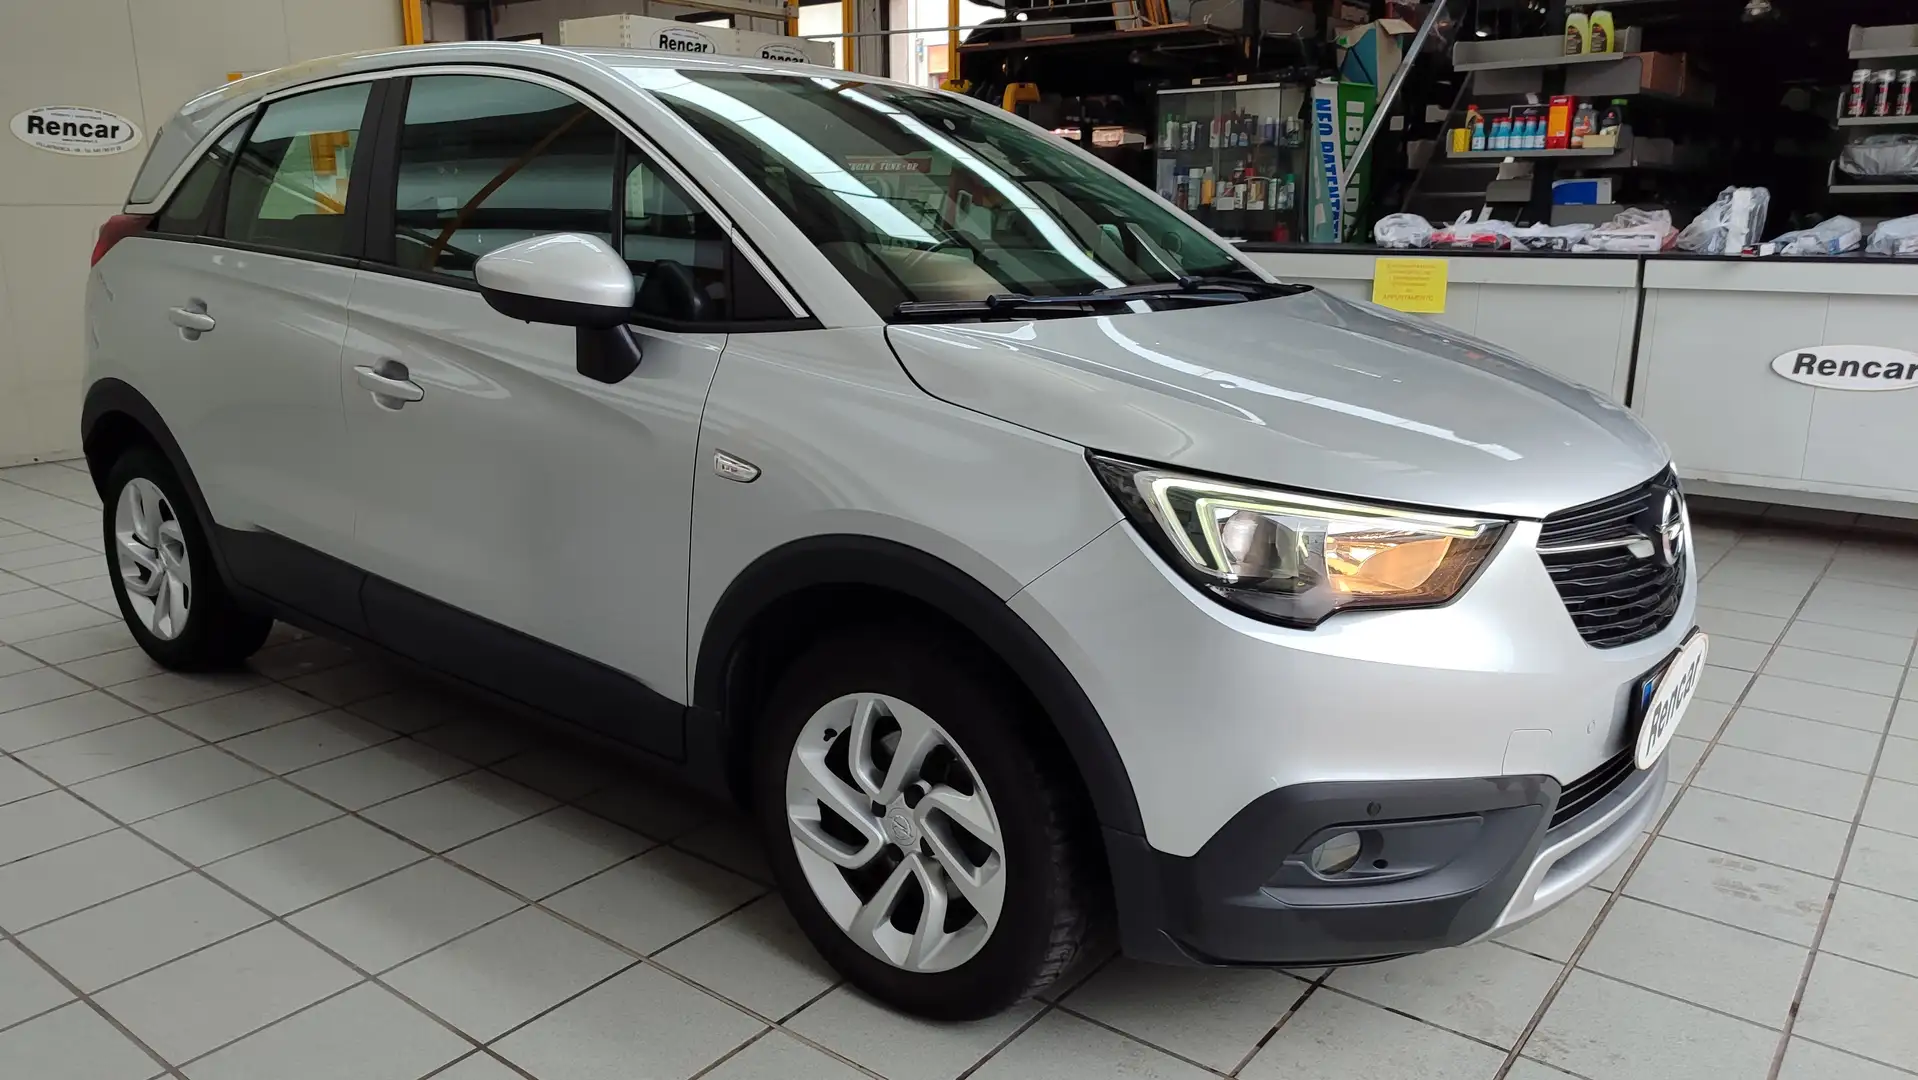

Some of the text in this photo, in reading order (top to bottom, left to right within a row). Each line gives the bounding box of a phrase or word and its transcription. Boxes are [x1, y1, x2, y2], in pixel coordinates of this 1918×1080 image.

[659, 34, 708, 53] Rencar
[27, 115, 120, 139] Rencar
[1792, 352, 1918, 381] Rencar
[1645, 652, 1702, 758] Rencar
